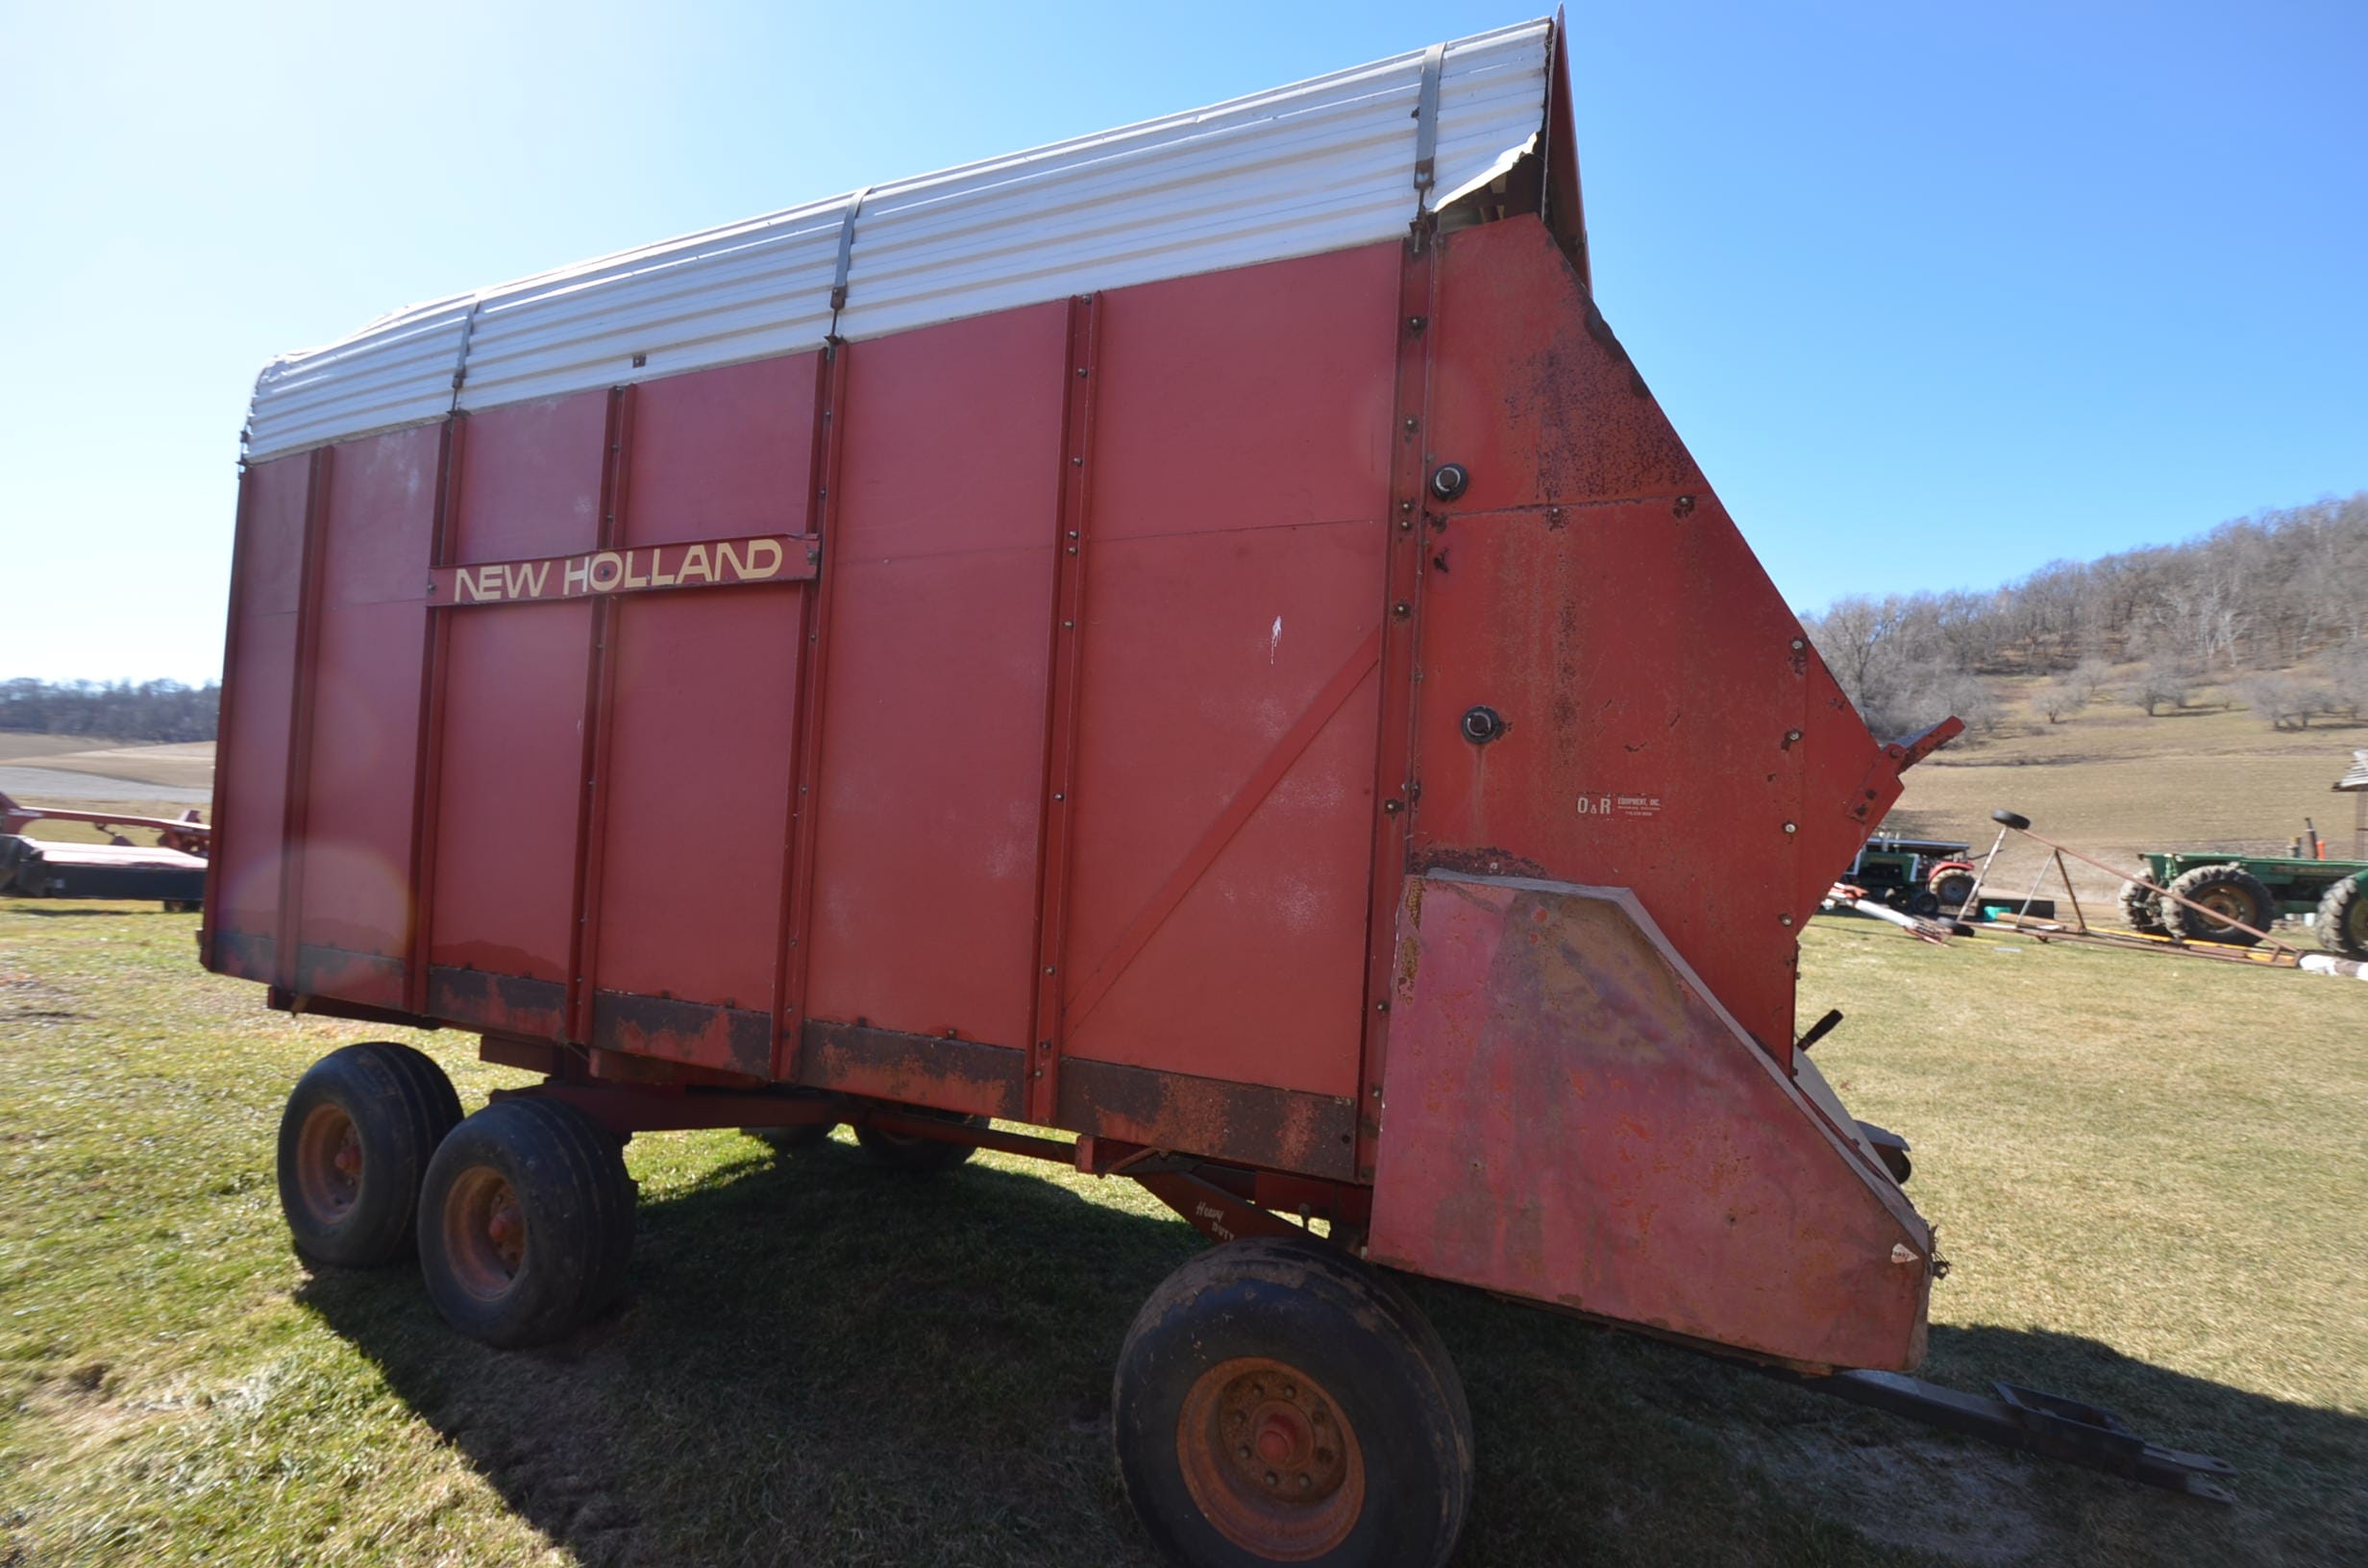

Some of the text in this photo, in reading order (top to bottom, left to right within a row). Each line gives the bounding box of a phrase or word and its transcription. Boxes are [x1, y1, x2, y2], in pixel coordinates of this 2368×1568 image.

[454, 538, 783, 602] NEW HOLLAND
[1577, 796, 1612, 815] O & R
